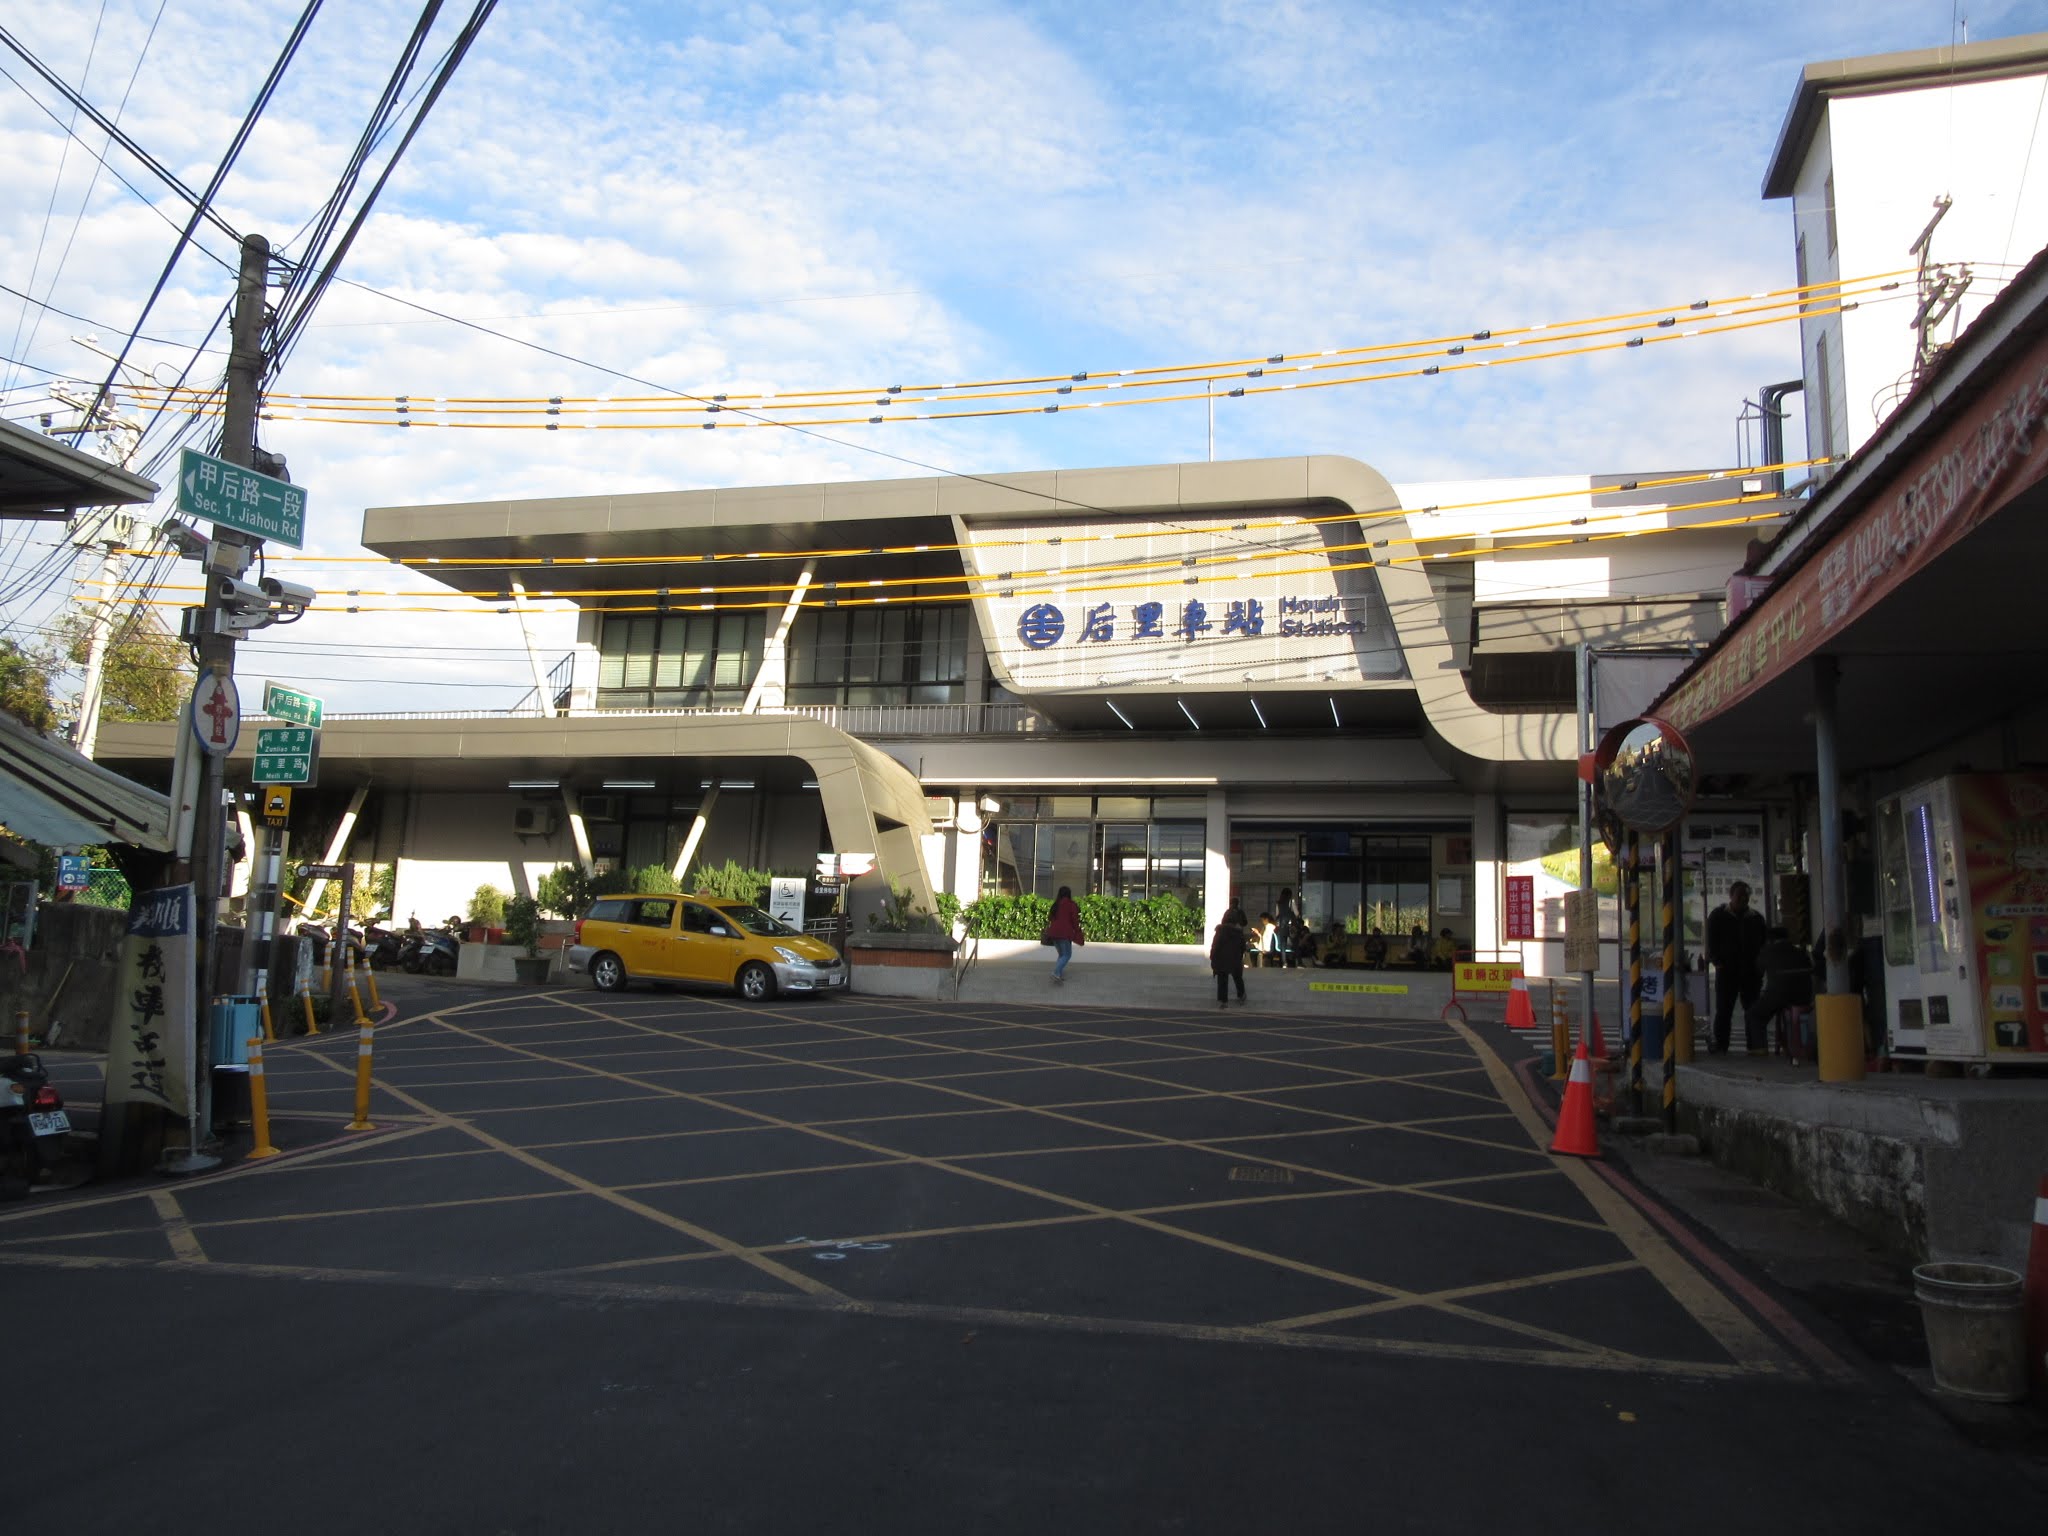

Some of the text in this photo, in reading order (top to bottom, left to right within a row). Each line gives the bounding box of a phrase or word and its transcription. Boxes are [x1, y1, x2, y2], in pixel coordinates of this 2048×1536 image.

[199, 460, 302, 520] 甲后路一段
[194, 492, 301, 539] Sec. 1, Jiahou Rd.
[1077, 597, 1265, 644] 后里車站
[1279, 616, 1366, 638] Station
[276, 692, 318, 712] 甲后路一段
[263, 731, 306, 743] 圳寮路
[260, 758, 303, 769] 梅里路
[267, 817, 283, 827] TAXI
[62, 858, 72, 870] P
[1508, 880, 1519, 936] 請出示證件
[1520, 880, 1532, 936] 右轉梅里路
